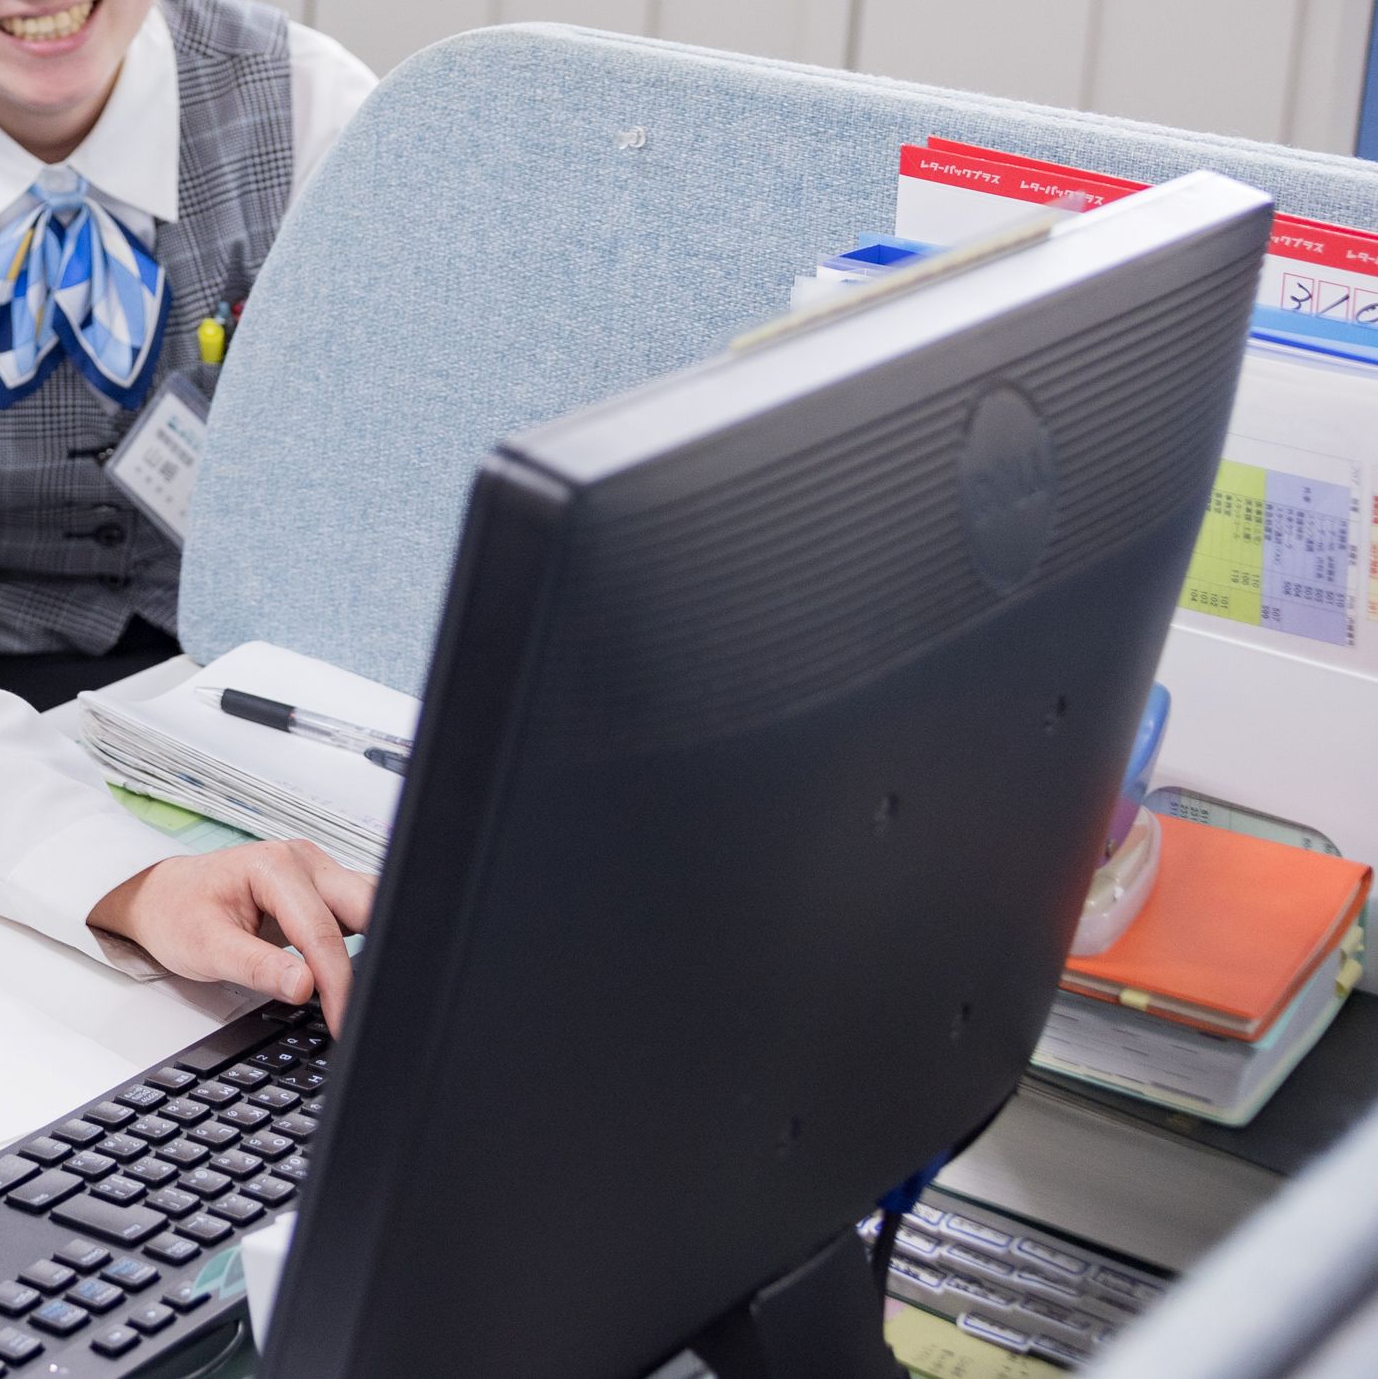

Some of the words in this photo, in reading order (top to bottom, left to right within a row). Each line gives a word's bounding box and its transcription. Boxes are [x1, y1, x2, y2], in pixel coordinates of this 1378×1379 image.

[919, 160, 1000, 184] レターパックプラス
[1020, 180, 1105, 205] レターパックラス
[1270, 235, 1324, 253] ックプラス
[1346, 250, 1378, 265] レター
[1210, 593, 1218, 606] 102
[308, 1037, 322, 1045] V
[279, 1053, 293, 1061] B
[248, 1069, 264, 1078] N
[307, 1075, 323, 1084] H
[218, 1086, 234, 1095] M
[248, 1109, 264, 1118] K
[218, 1127, 233, 1135] L
